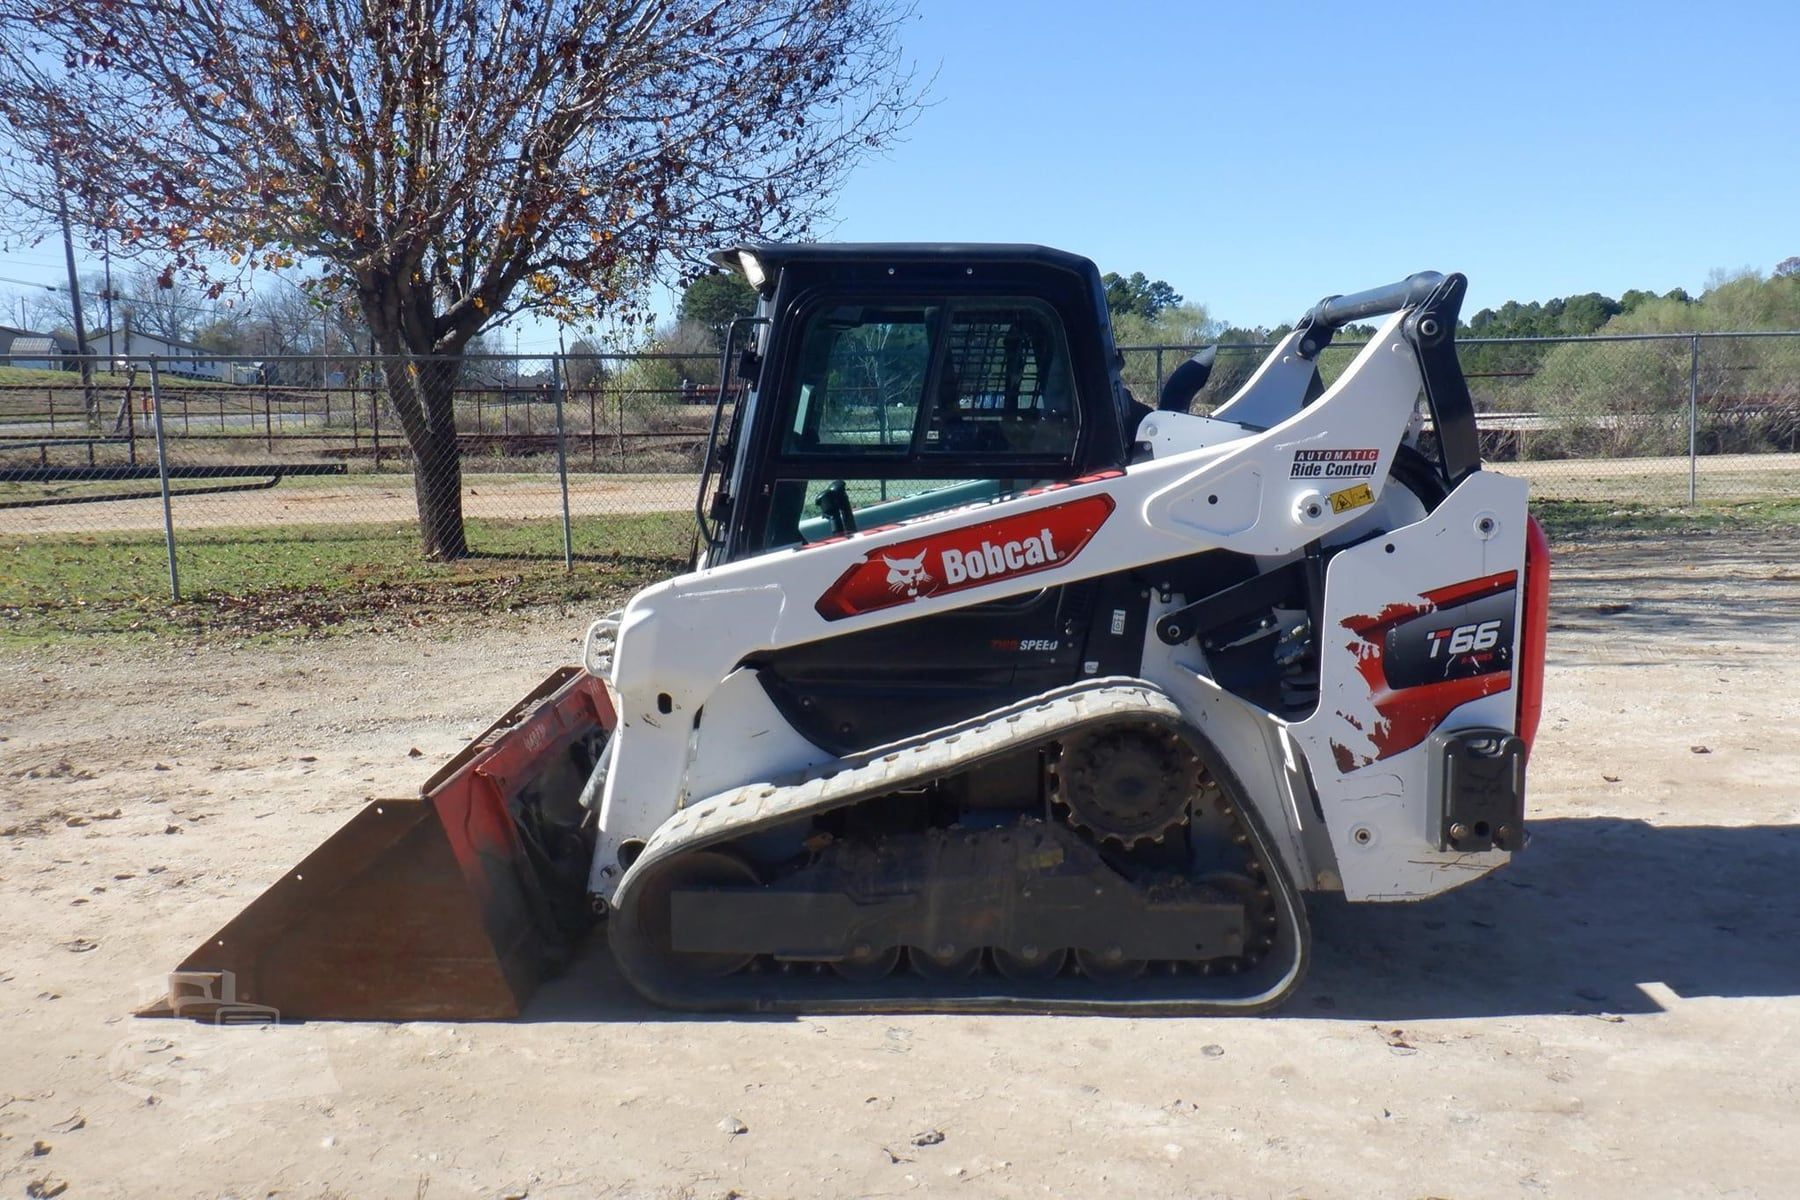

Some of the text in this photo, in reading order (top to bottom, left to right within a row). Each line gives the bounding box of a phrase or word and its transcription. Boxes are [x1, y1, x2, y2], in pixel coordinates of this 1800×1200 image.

[1297, 450, 1377, 461] AUTOMATIC
[1290, 462, 1377, 477] Ride Control
[940, 527, 1059, 585] Bobcat
[1020, 639, 1059, 651] SPEED
[1426, 619, 1502, 659] T66
